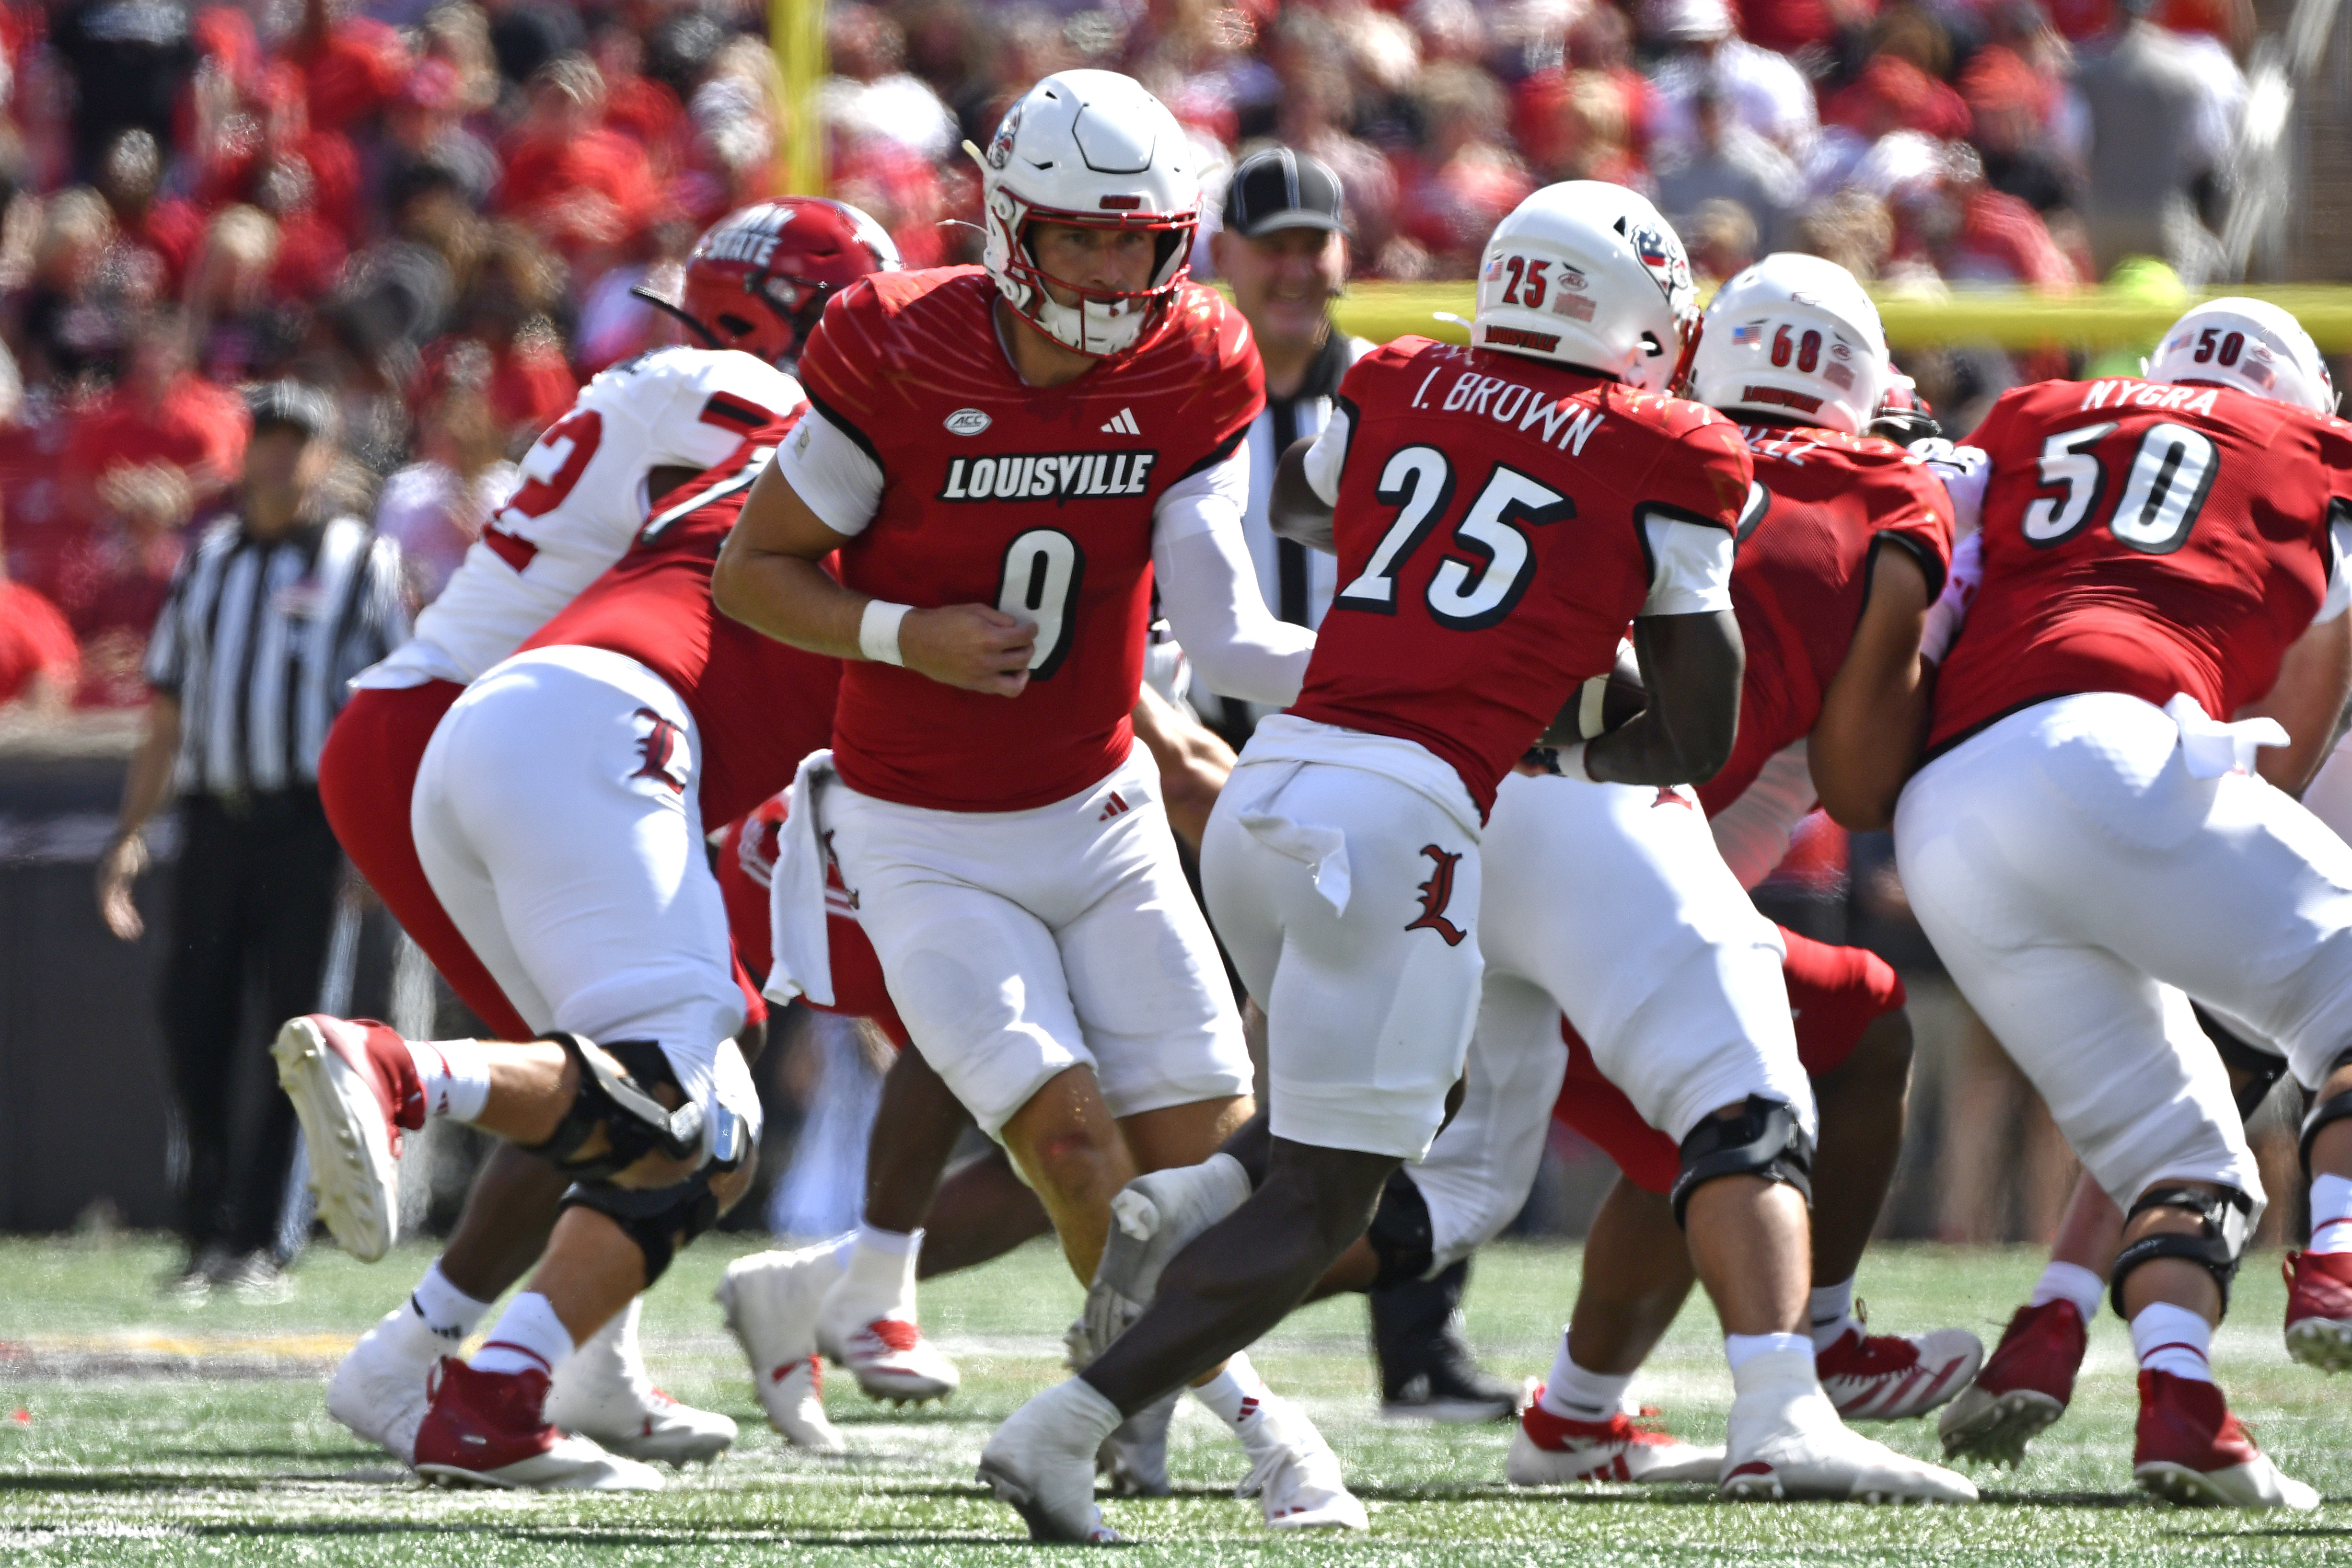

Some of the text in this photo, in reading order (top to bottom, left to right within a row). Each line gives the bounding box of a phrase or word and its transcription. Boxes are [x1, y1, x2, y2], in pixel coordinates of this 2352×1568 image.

[706, 231, 782, 267] STATE
[1502, 255, 1552, 308] 25
[1484, 324, 1561, 353] LOUISVILLE
[1771, 324, 1821, 372] 68
[2194, 327, 2245, 367] 50
[951, 415, 983, 425] ACC
[1443, 372, 1605, 457] BROWN
[2081, 380, 2218, 416] NYGRA
[938, 451, 1156, 506] LOUISVILLE
[2022, 422, 2221, 555] 50
[1335, 444, 1574, 629] 25
[1404, 844, 1467, 946] L
